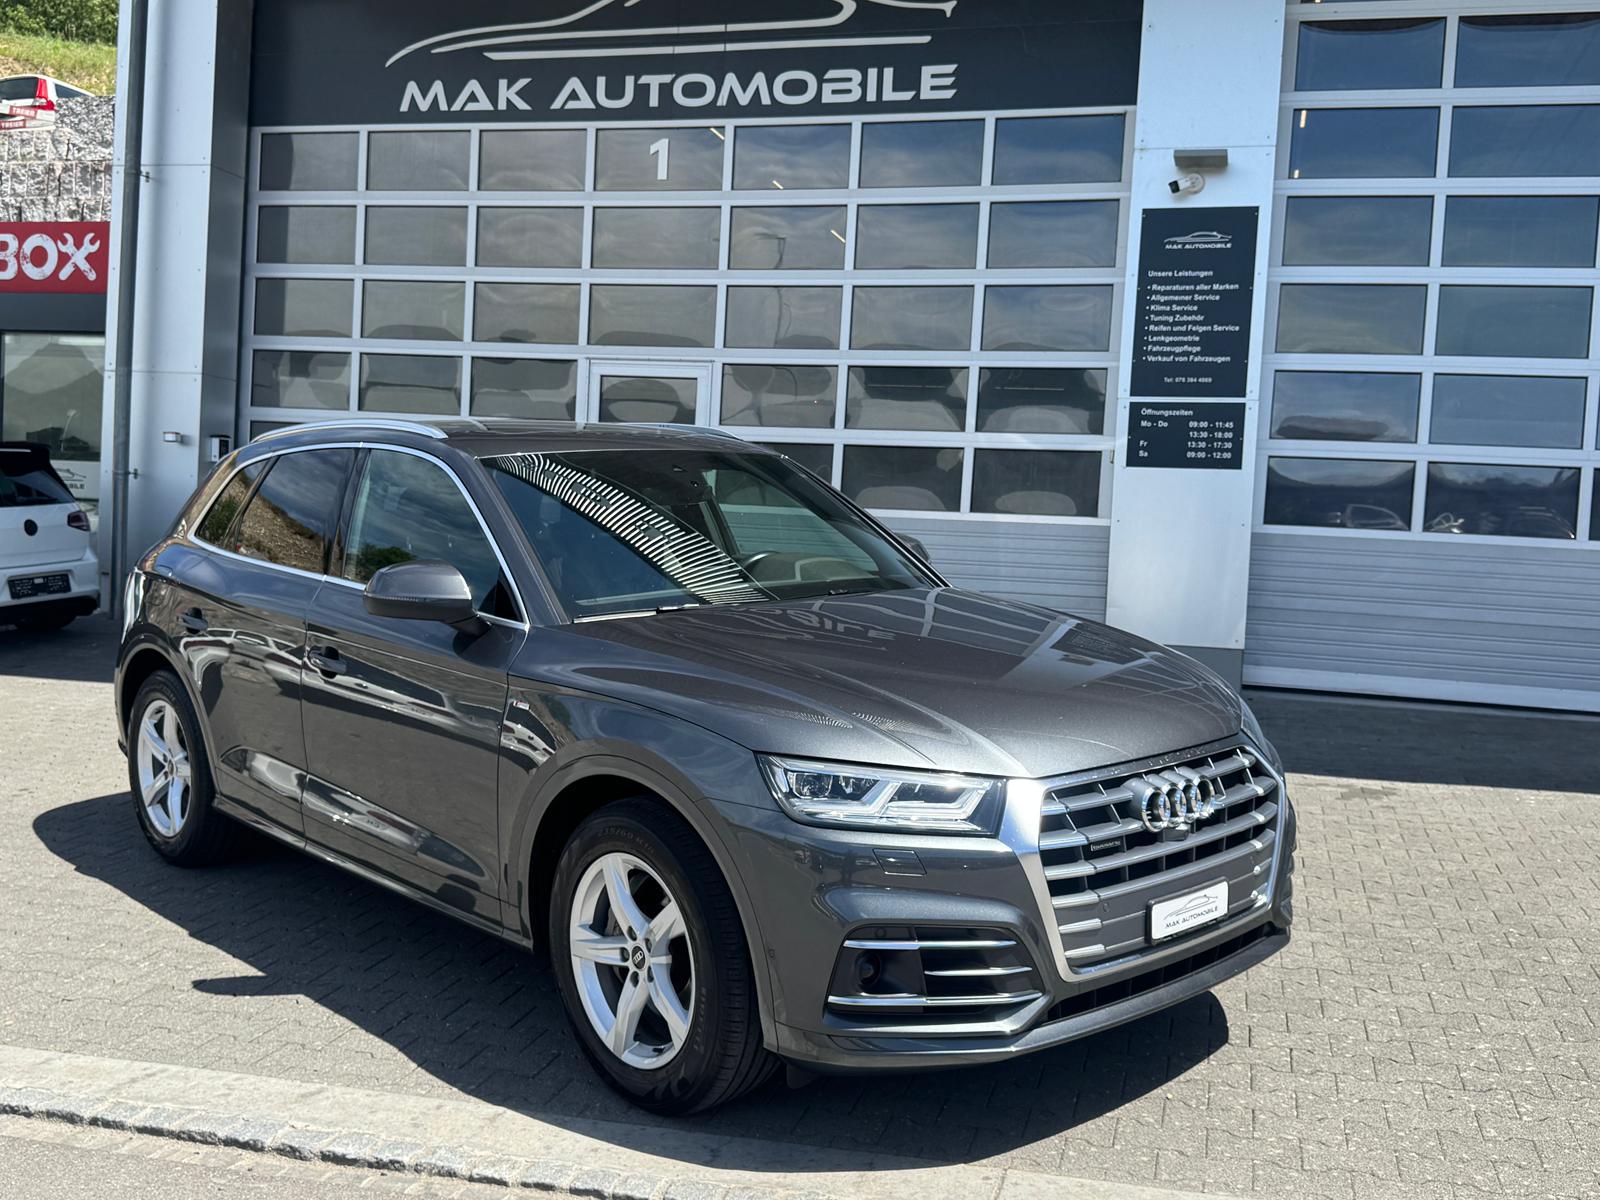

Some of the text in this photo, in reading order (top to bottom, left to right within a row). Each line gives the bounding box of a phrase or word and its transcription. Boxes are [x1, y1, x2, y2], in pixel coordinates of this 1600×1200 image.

[400, 64, 958, 112] MAK AUTOMOBILE
[649, 138, 669, 181] 1
[1184, 242, 1233, 250] AUTOMOBILE
[1148, 269, 1214, 278] Unsere Leistungen
[1152, 283, 1240, 292] Reparaturen aller Marken
[1151, 293, 1221, 302] Allgemeiner Service
[1151, 303, 1199, 312] Klima Service
[1150, 313, 1205, 322] Tuning Zubehör
[1149, 323, 1240, 332] Reifen und Felgen Service
[1148, 334, 1201, 343] Lenkgeometrie
[1148, 344, 1202, 353] Fahrzeugpflege
[1147, 354, 1174, 362] Verkauf
[1189, 354, 1231, 363] Fahrzeugen
[1141, 407, 1194, 417] Öffnungszeiten
[1215, 421, 1234, 429] 11:45
[1214, 441, 1233, 449] 17:30
[1165, 906, 1218, 928] MAK AUTOMOBILE
